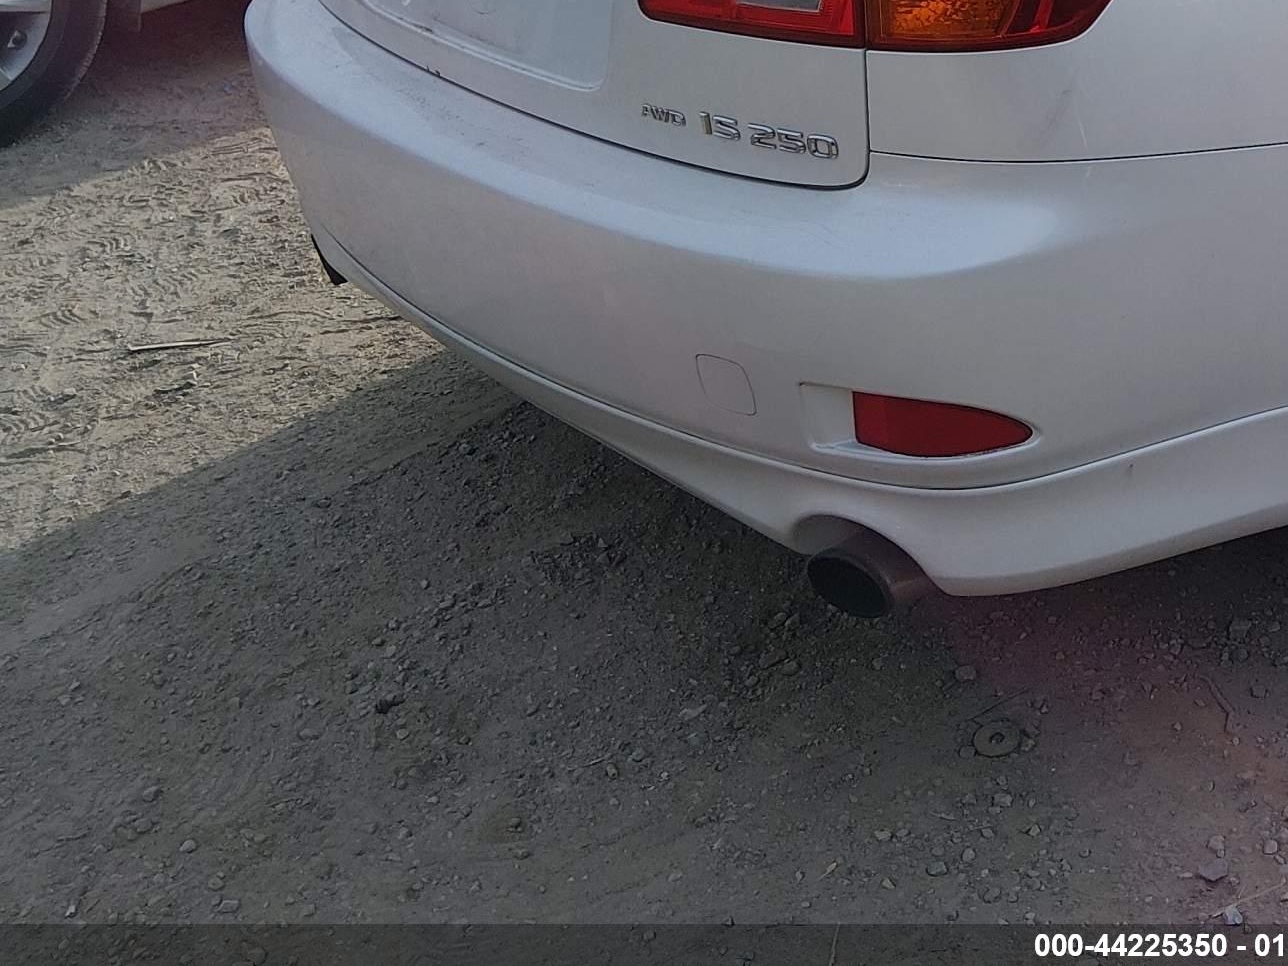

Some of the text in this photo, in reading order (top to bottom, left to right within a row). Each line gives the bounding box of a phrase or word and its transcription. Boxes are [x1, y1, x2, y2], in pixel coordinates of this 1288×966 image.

[641, 103, 840, 160] AWD IS 250
